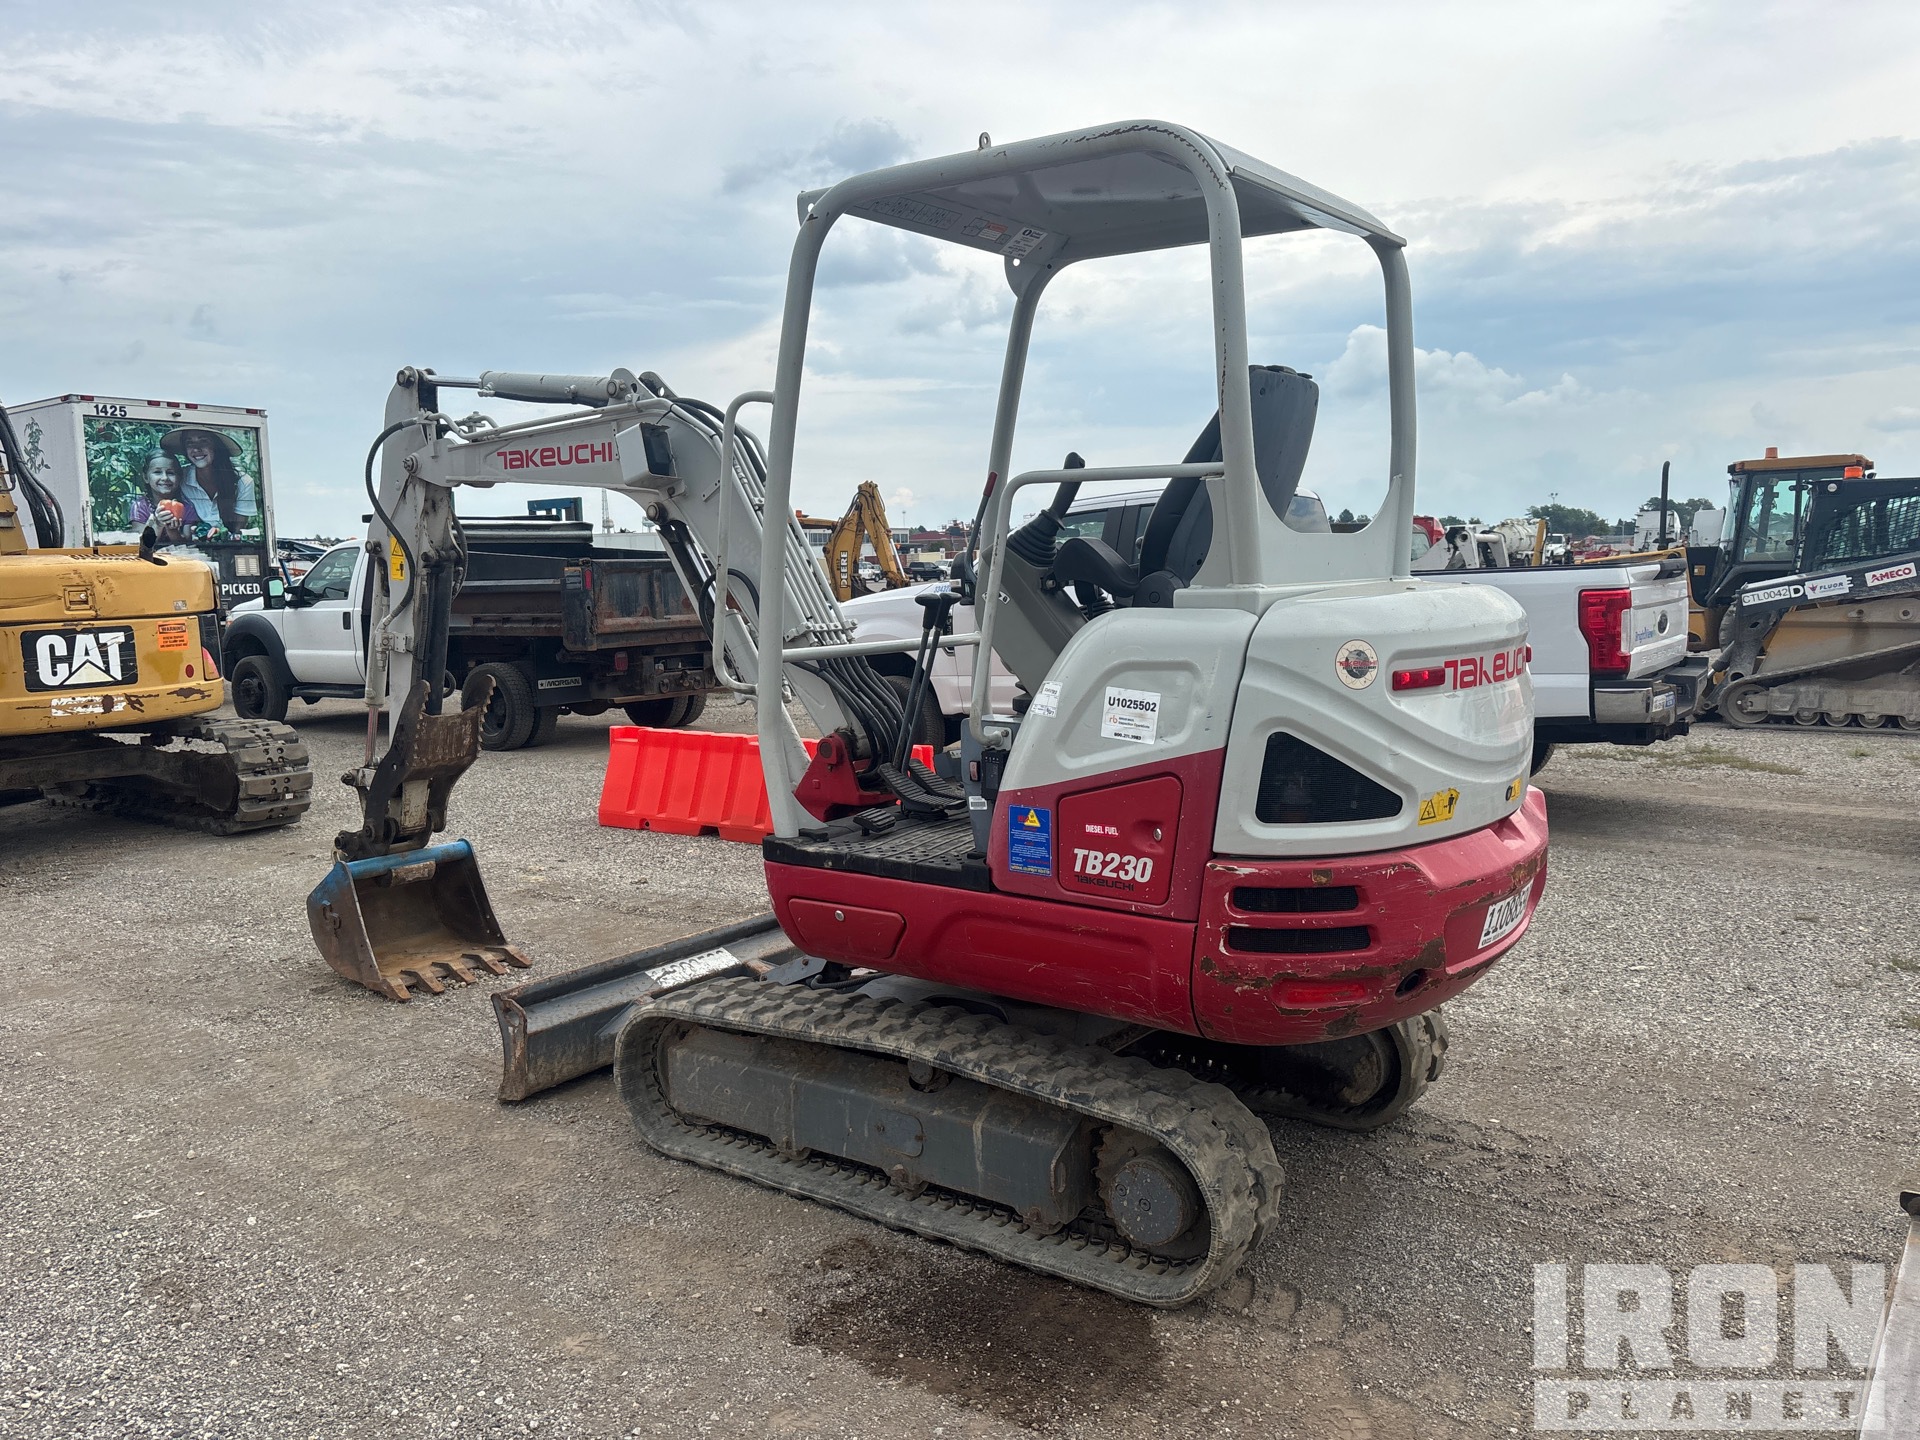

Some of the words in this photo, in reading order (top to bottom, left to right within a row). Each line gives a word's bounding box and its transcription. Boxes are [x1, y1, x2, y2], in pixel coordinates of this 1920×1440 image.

[93, 404, 127, 417] 1425
[497, 441, 613, 469] TAKEUCHI
[840, 551, 848, 588] DEERE
[1871, 567, 1912, 583] AMECO
[221, 583, 263, 595] PICKED.
[1819, 582, 1844, 590] FLUOR
[1742, 588, 1788, 604] CTL0042
[36, 632, 125, 686] CAT
[546, 679, 580, 688] MORGAN
[1108, 696, 1157, 712] U1025502
[1085, 824, 1104, 834] DIESEL
[1104, 826, 1119, 836] FUEL
[1073, 848, 1154, 883] TB230
[1074, 874, 1134, 891] TAKEUCHI
